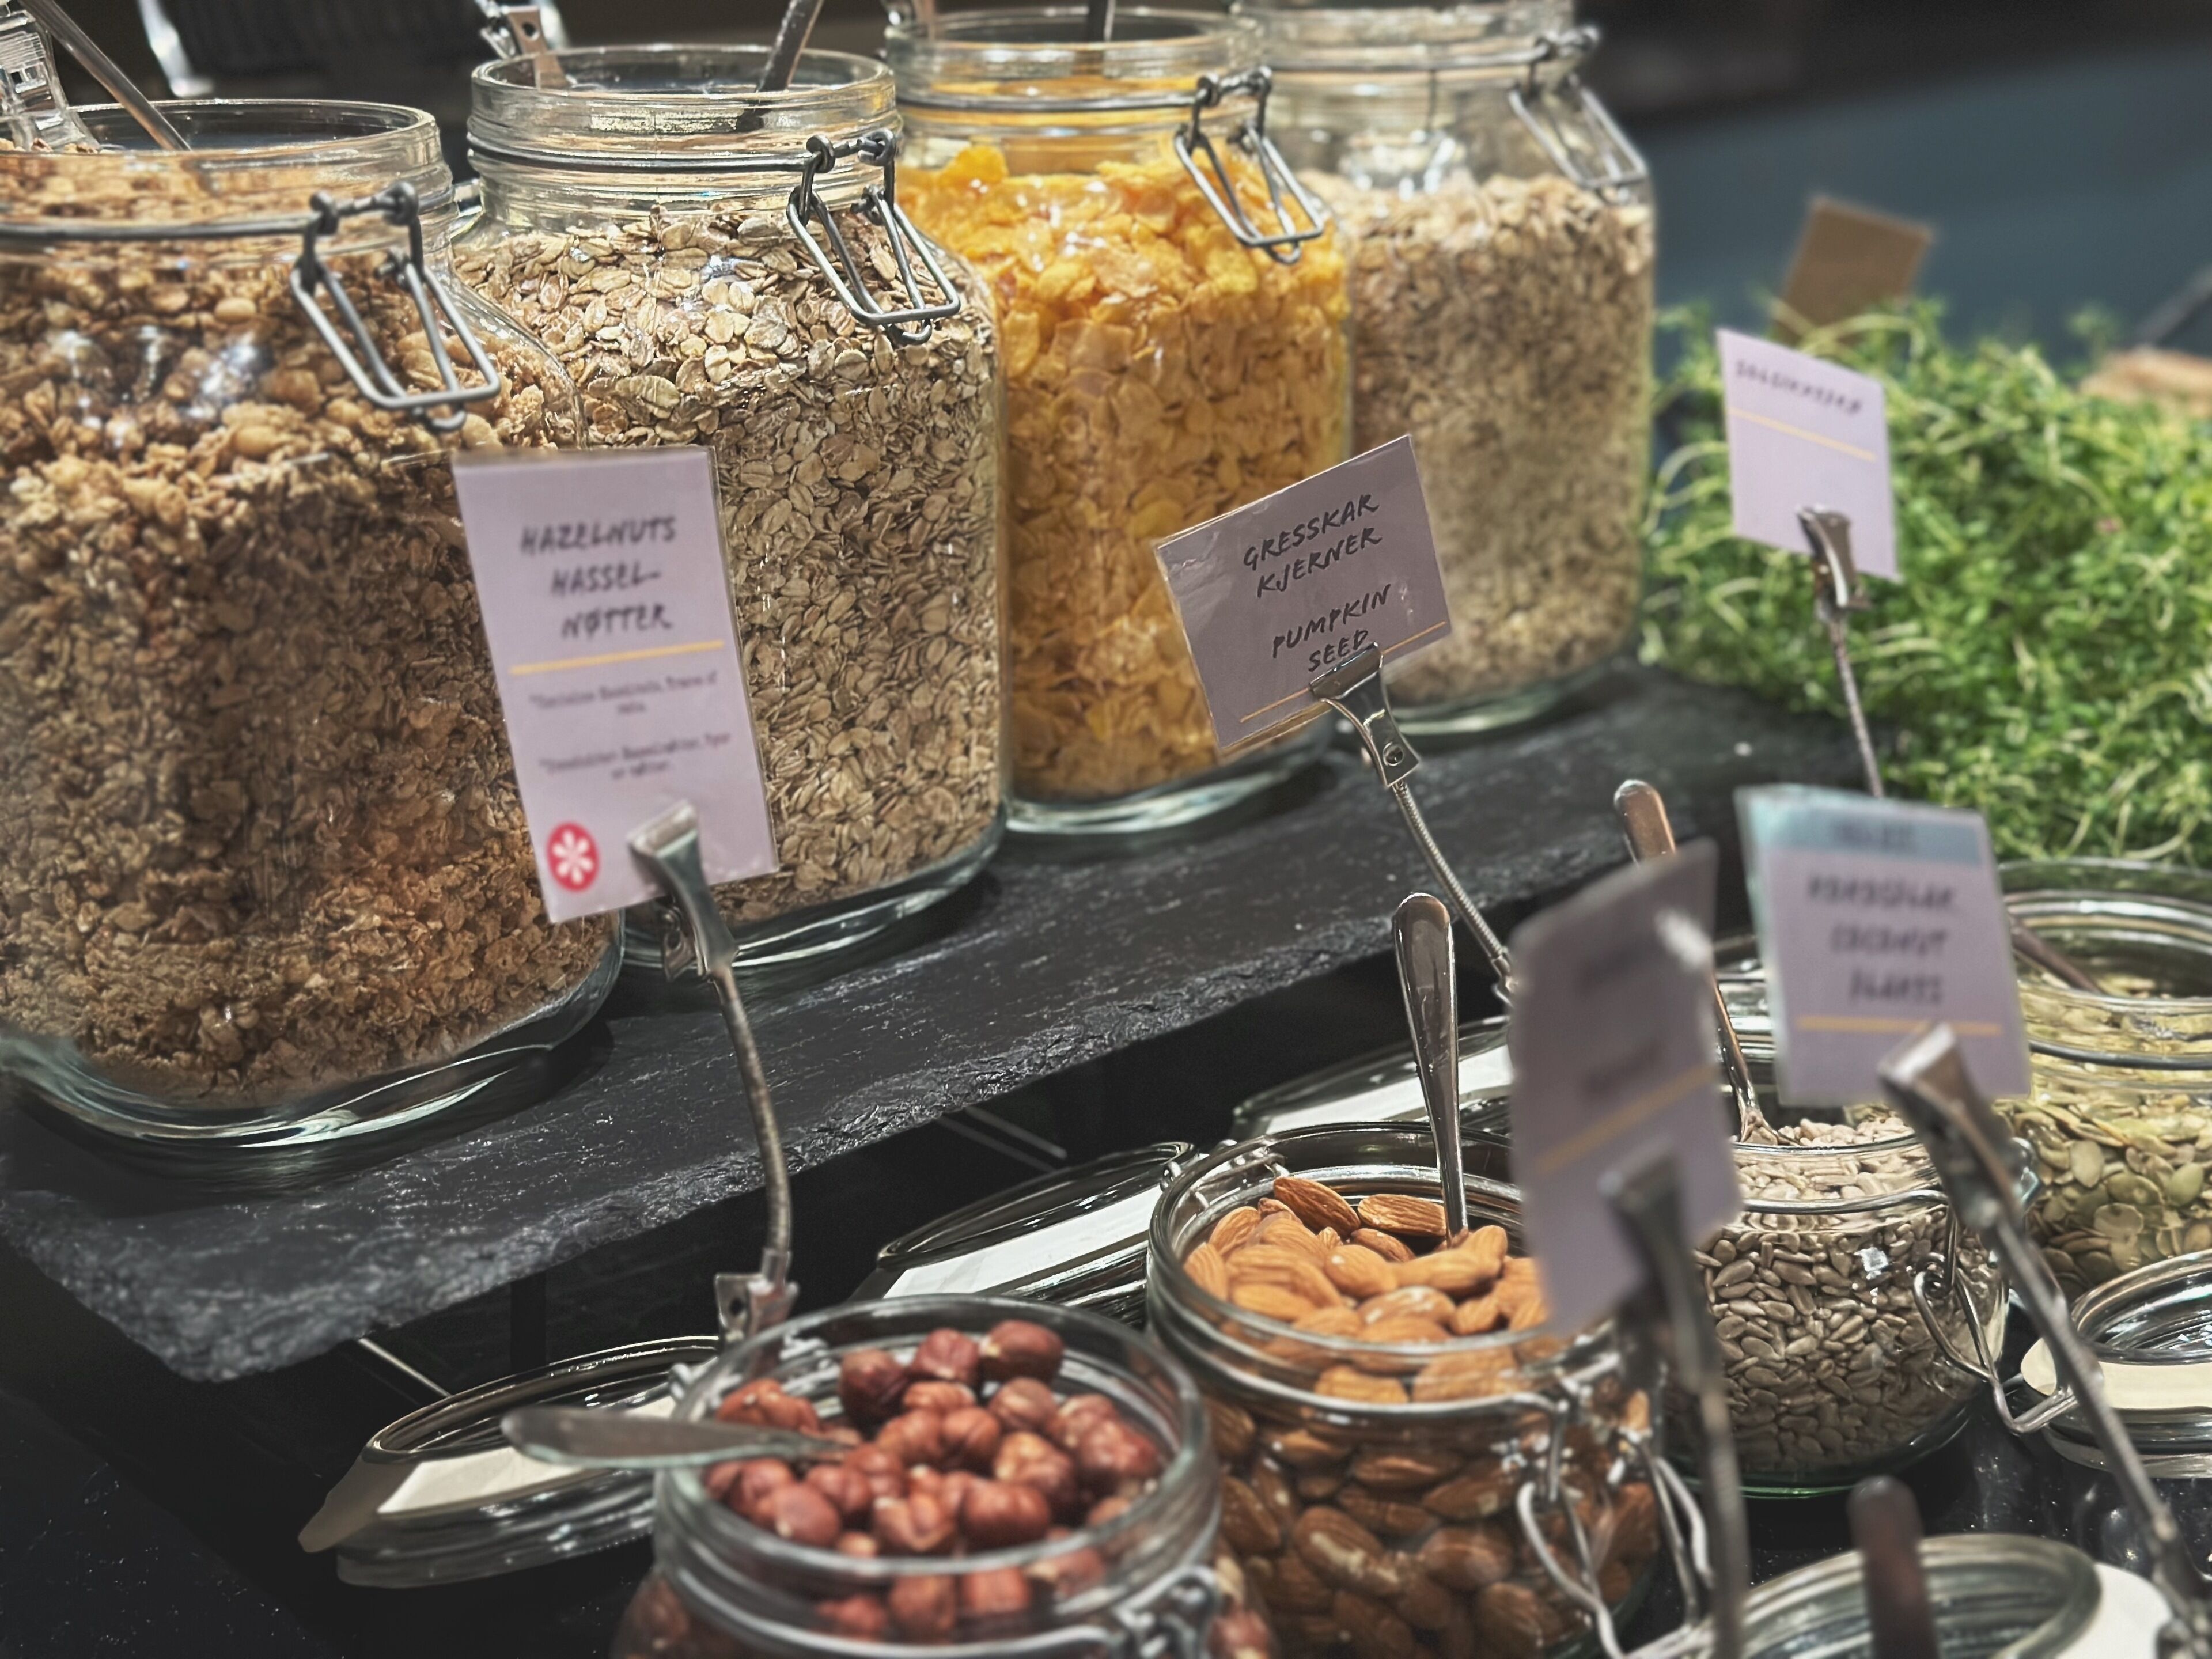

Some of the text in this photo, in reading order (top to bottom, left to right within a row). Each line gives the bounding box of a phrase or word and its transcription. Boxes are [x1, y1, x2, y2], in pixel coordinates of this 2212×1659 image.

[522, 517, 676, 554] HAZELNUTS
[1243, 494, 1380, 571] GRESSKAR
[1257, 527, 1382, 599] KJERNER
[563, 603, 672, 639] NØTTER
[1272, 584, 1391, 659] PUMPKIN
[1308, 630, 1369, 672] SEED
